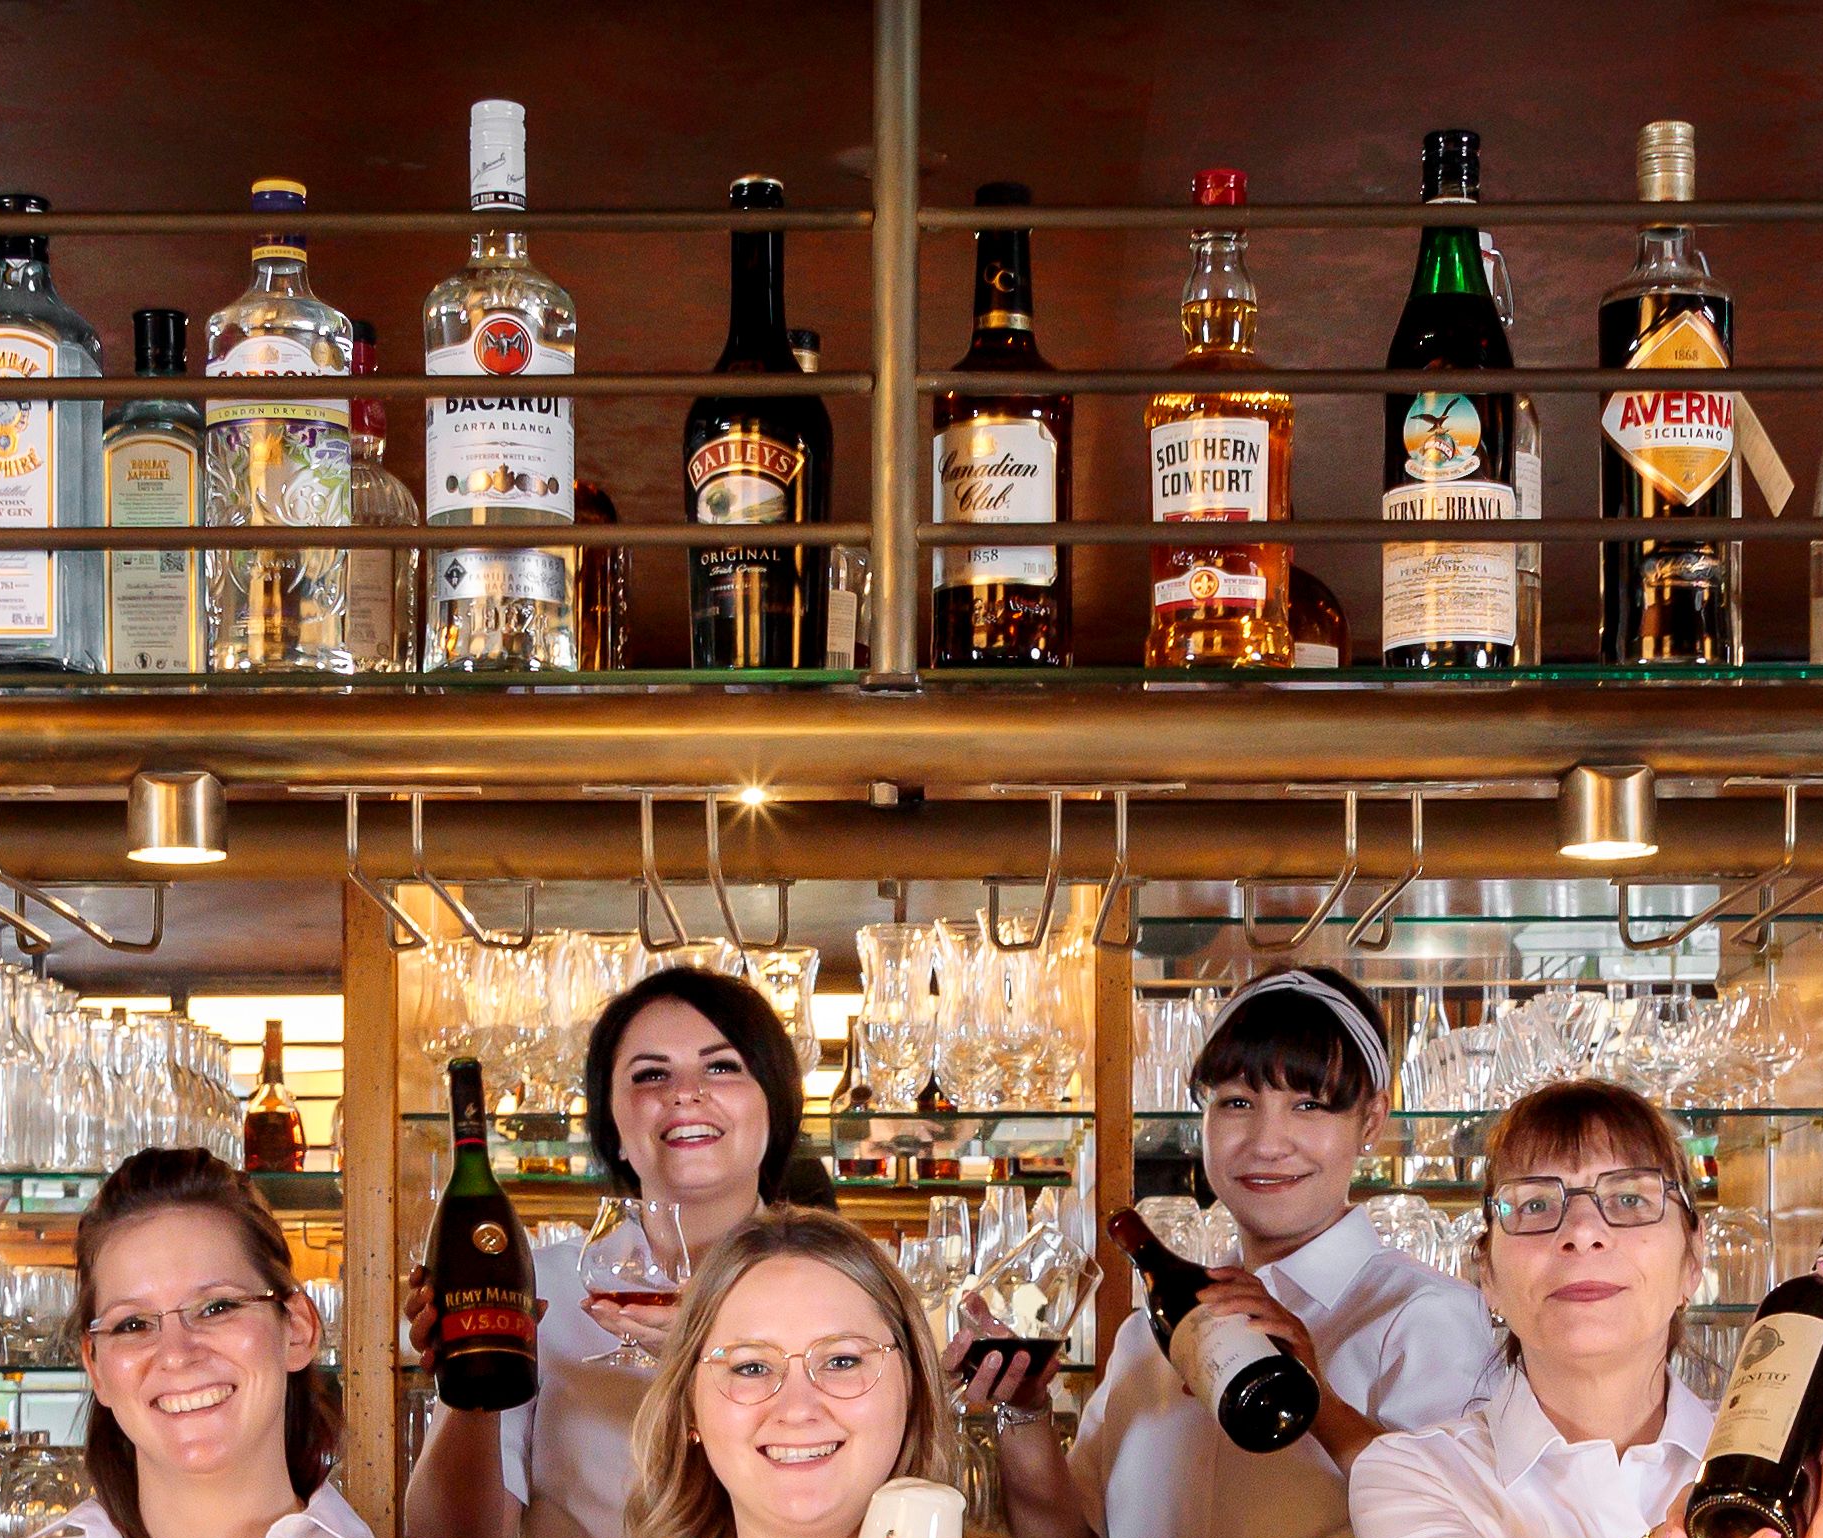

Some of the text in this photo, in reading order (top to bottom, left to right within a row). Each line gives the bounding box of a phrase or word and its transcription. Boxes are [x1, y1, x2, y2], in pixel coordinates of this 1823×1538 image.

[1674, 350, 1699, 362] 1868
[218, 407, 327, 419] LONDON DRY GIN
[1619, 391, 1734, 432] AVERNA
[454, 421, 552, 435] CARTA BLANCA
[1644, 427, 1724, 441] SICILIANO
[691, 442, 791, 480] BAILEYS
[1156, 437, 1261, 473] SOUTHERN
[938, 449, 1040, 487] Canadian
[1162, 469, 1253, 499] COMFORT
[954, 480, 1015, 513] Club
[7, 507, 33, 517] GIN
[700, 549, 781, 566] ORIGINAL
[967, 549, 999, 564] 1858
